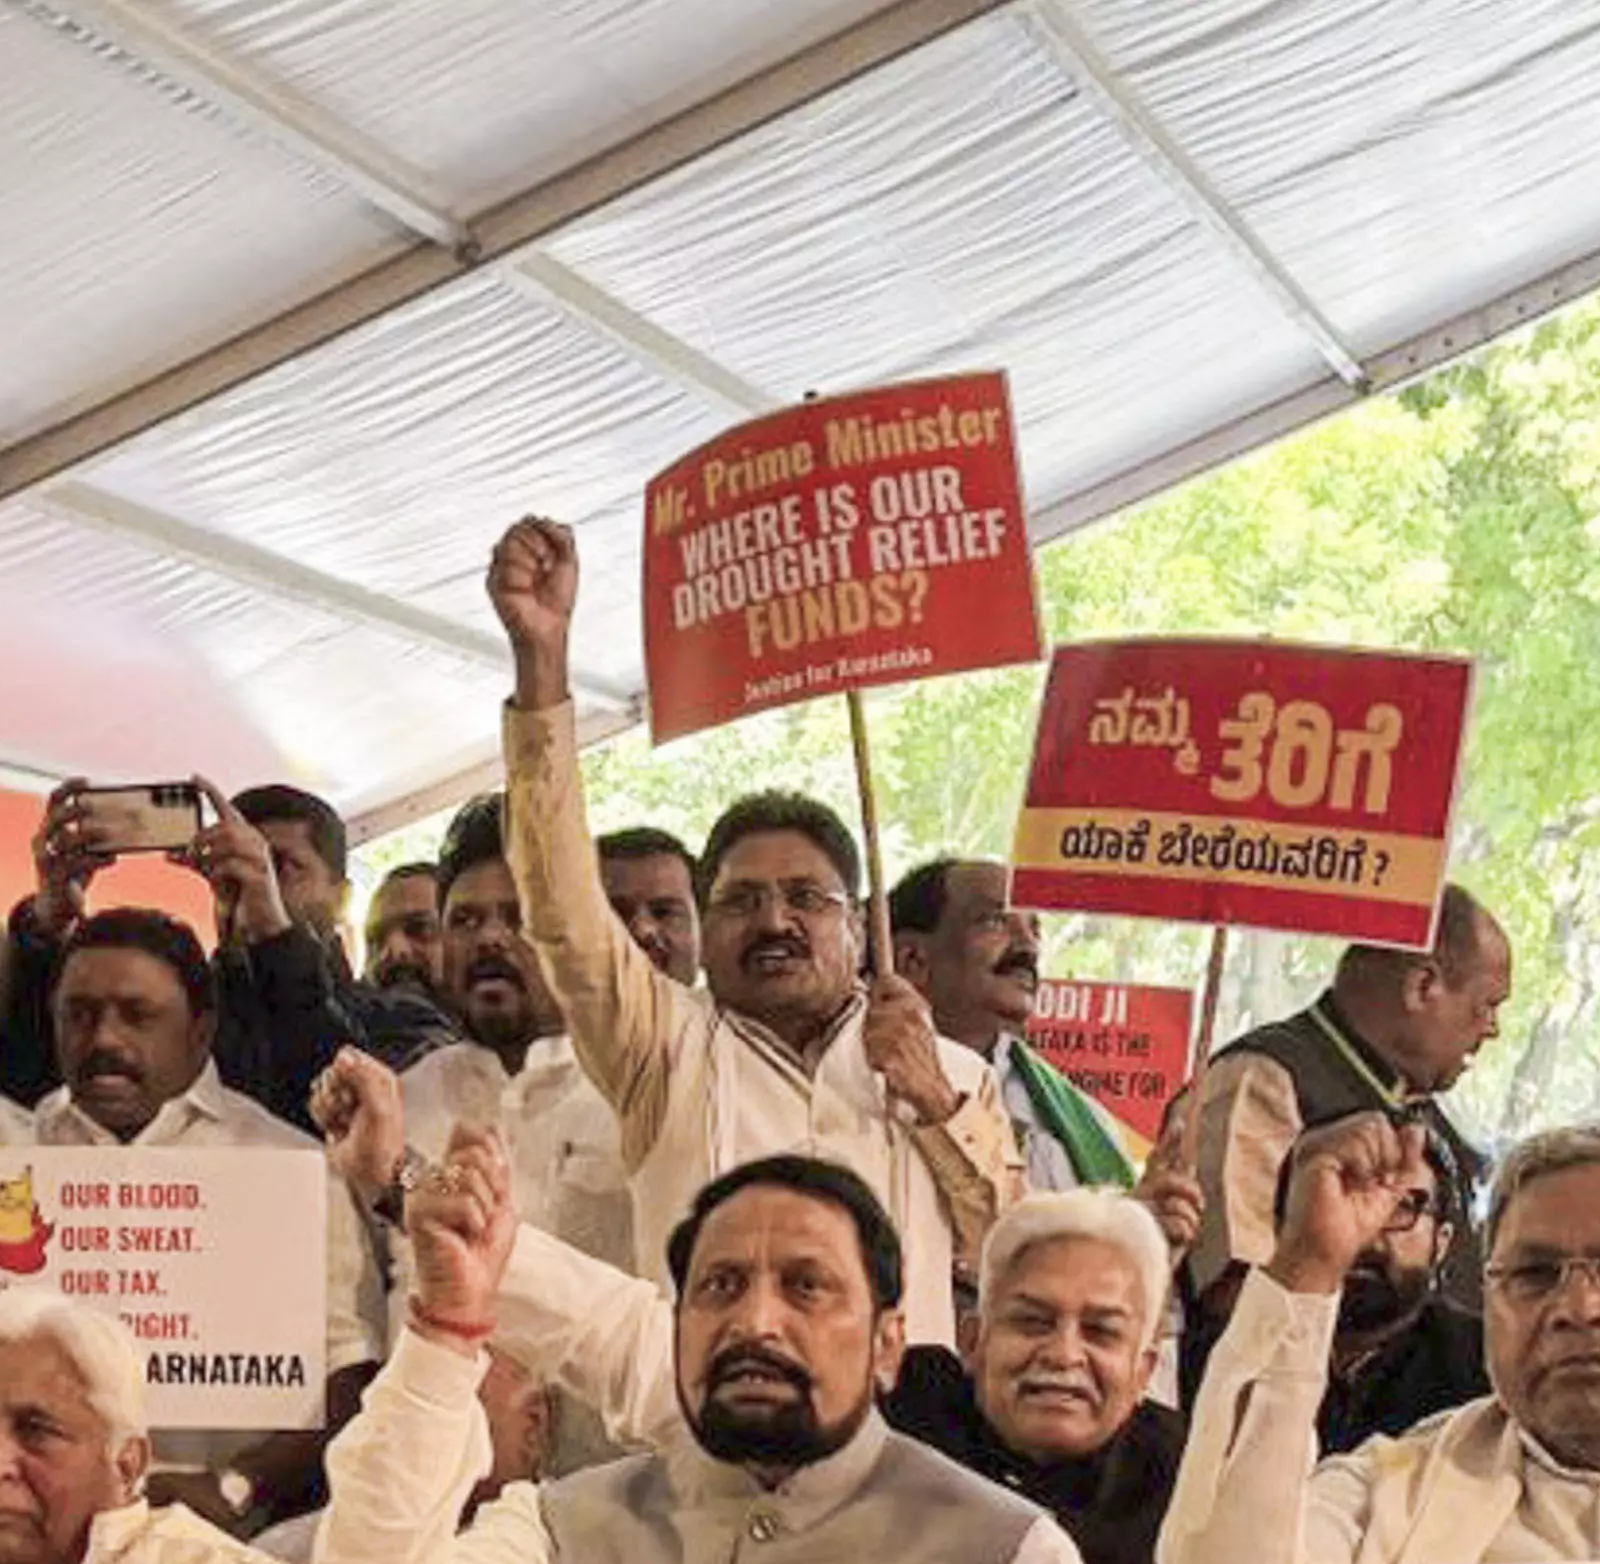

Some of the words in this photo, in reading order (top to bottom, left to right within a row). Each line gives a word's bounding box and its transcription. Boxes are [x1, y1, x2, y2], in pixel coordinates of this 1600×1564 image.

[653, 485, 696, 537] Mr.
[704, 442, 813, 504] Prime
[824, 405, 1000, 469] Minister
[680, 496, 801, 578] WHERE
[815, 483, 858, 533] IS
[869, 466, 964, 522] OUR
[672, 535, 852, 630] DROUGHT
[869, 509, 1006, 573] RELIEF
[744, 572, 930, 659] FUNDS?
[806, 664, 833, 686] for
[1088, 685, 1199, 774] ನಮ್ಮ
[1210, 693, 1403, 813] ತೆರಿಗೆ
[1061, 819, 1150, 863] ಯಾಕೆ
[1036, 983, 1091, 1023] ODI
[61, 1183, 109, 1208] OUR
[118, 1183, 206, 1210] BLOOD.
[60, 1227, 109, 1251] OUR
[117, 1227, 201, 1252] SWEAT.
[60, 1270, 109, 1295] OUR
[117, 1270, 168, 1296] TAX.
[146, 1352, 305, 1387] ARNATAKA
